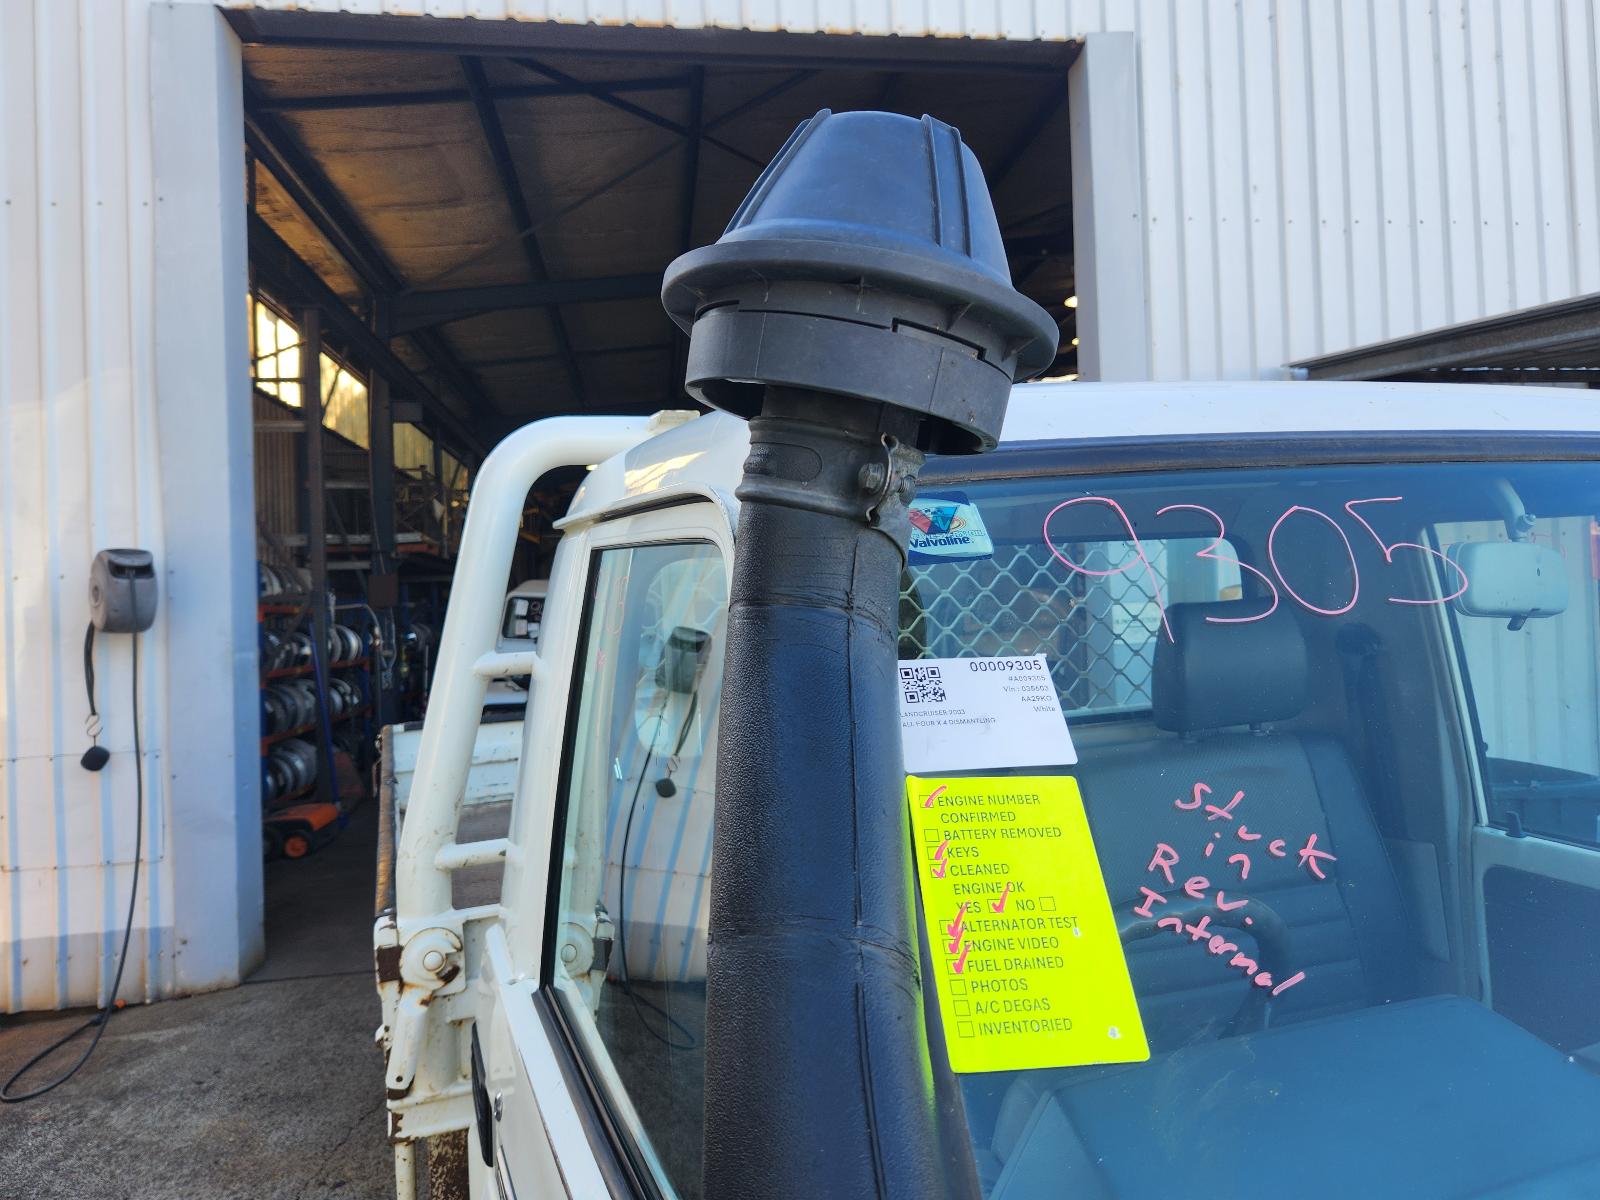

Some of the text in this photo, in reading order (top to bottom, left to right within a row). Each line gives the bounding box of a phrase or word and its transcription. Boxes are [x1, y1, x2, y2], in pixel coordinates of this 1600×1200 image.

[909, 536, 971, 548] Valvoline
[1042, 495, 1469, 644] 9305
[969, 659, 1042, 672] 00009305
[937, 794, 1041, 807] ENGINE NUMBER
[940, 811, 1017, 824] CONFIRMED
[944, 827, 1062, 841] BATTERY REMOVED
[946, 846, 980, 858] KEYS
[949, 864, 1010, 877] CLEANED
[953, 881, 1025, 895] ENGINE OK
[955, 899, 1036, 914] YES NO
[960, 916, 1079, 933] ALTERNATOR TEST
[963, 936, 1060, 953] ENGINE VIDEO
[967, 956, 1065, 972] FUEL DRAINED
[971, 978, 1029, 993] PHOTOS
[975, 998, 1051, 1015] A/C DEGAS
[978, 1018, 1073, 1036] INVENTORIED
